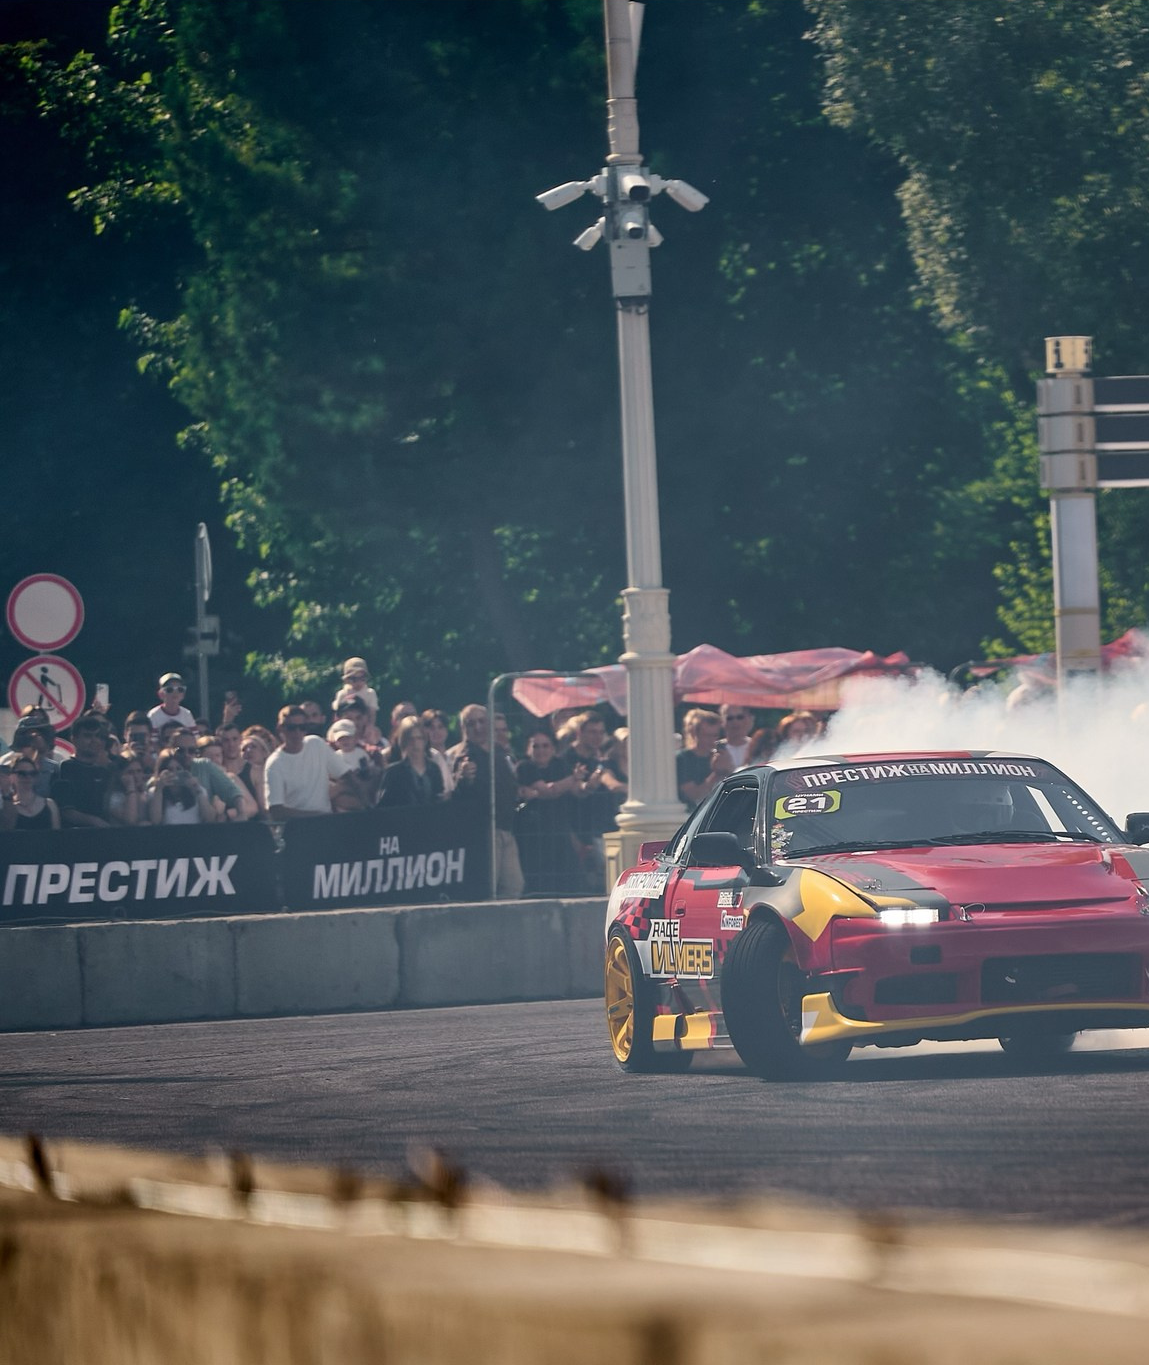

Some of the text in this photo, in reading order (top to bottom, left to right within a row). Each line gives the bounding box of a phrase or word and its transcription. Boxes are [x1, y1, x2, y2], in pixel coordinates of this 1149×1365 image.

[802, 763, 1037, 788] ПРЕСТИЖ НА МИЛЛИОН
[788, 797, 826, 811] 21
[379, 835, 400, 856] НА
[2, 854, 239, 906] ПРЕСТИЖ
[313, 848, 466, 899] МИЛЛИОН
[652, 921, 679, 938] RACE
[650, 941, 714, 975] VILMERS
